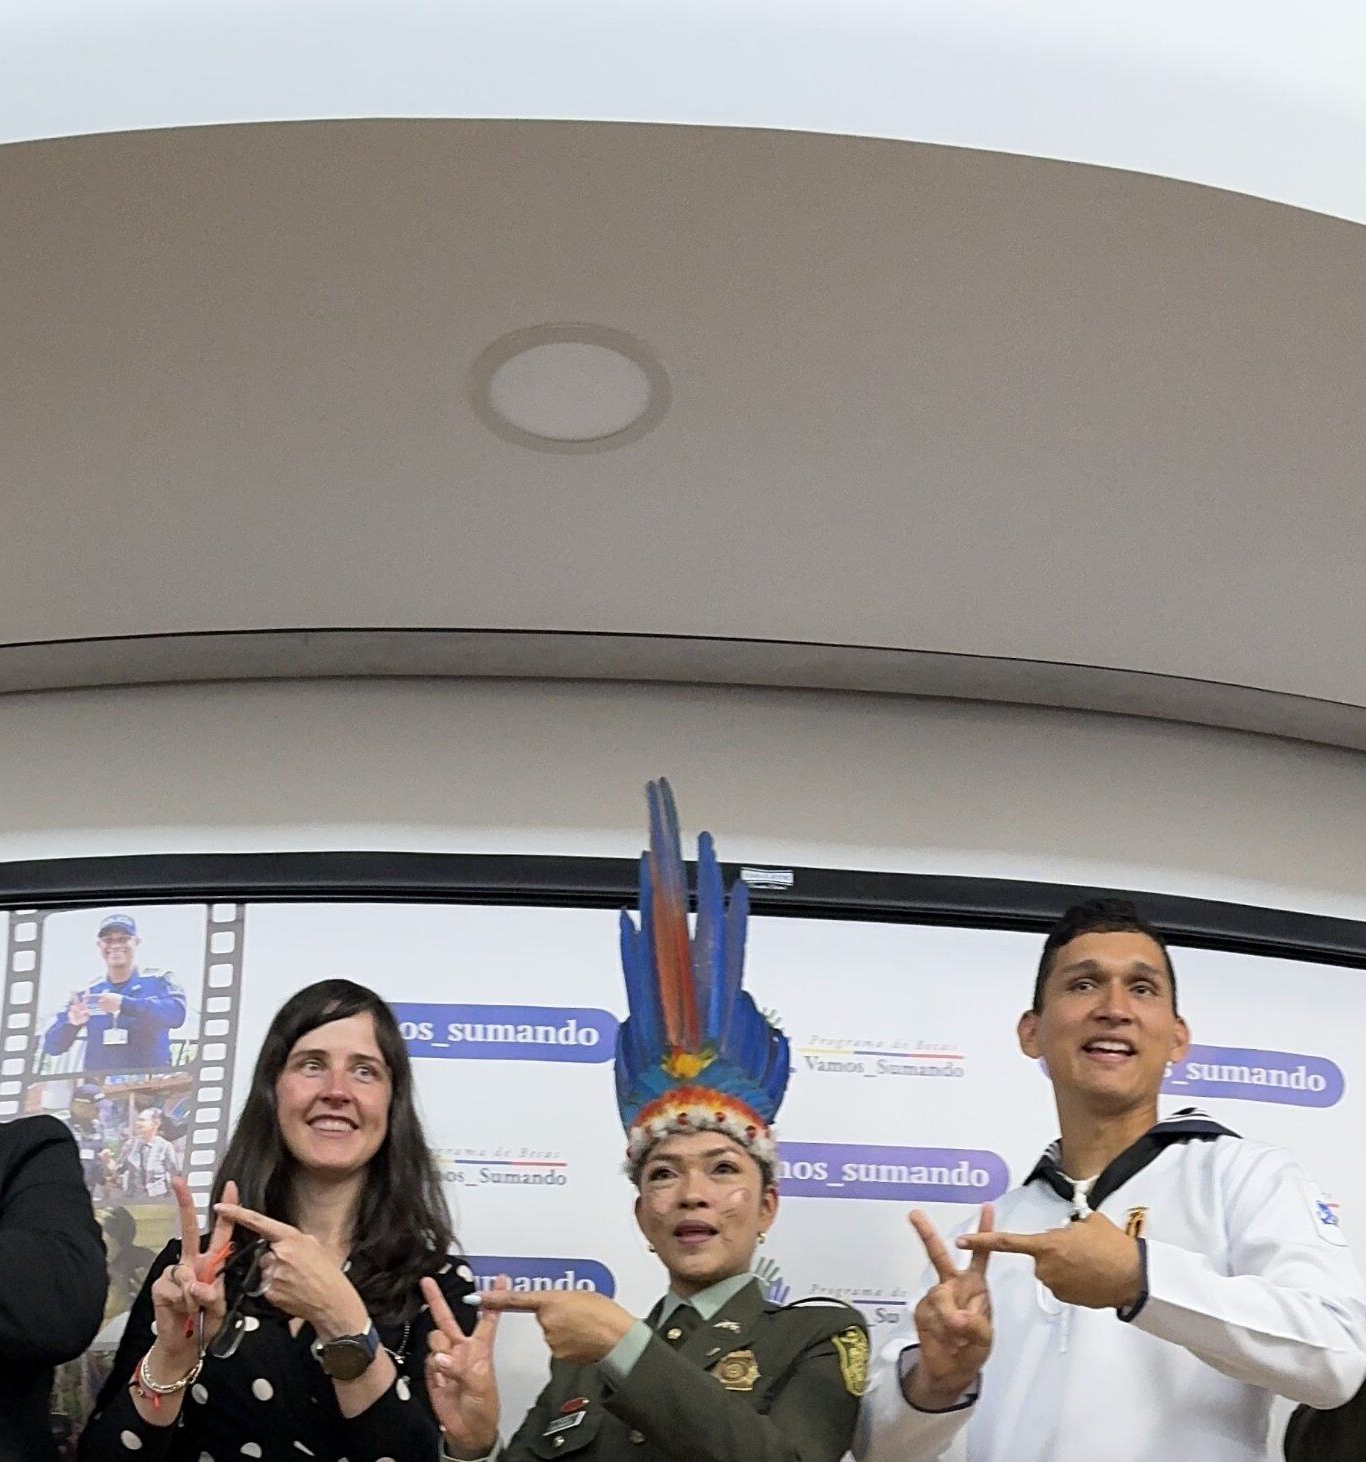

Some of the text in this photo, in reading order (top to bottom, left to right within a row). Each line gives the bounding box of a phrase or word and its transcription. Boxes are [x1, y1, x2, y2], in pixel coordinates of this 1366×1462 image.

[398, 1018, 601, 1048] os_sumando
[803, 1055, 965, 1079] Vamos_Sumando
[1163, 1060, 1327, 1092] s_sumando
[438, 1168, 568, 1186] os_Sumando
[777, 1160, 990, 1188] mos_sumando
